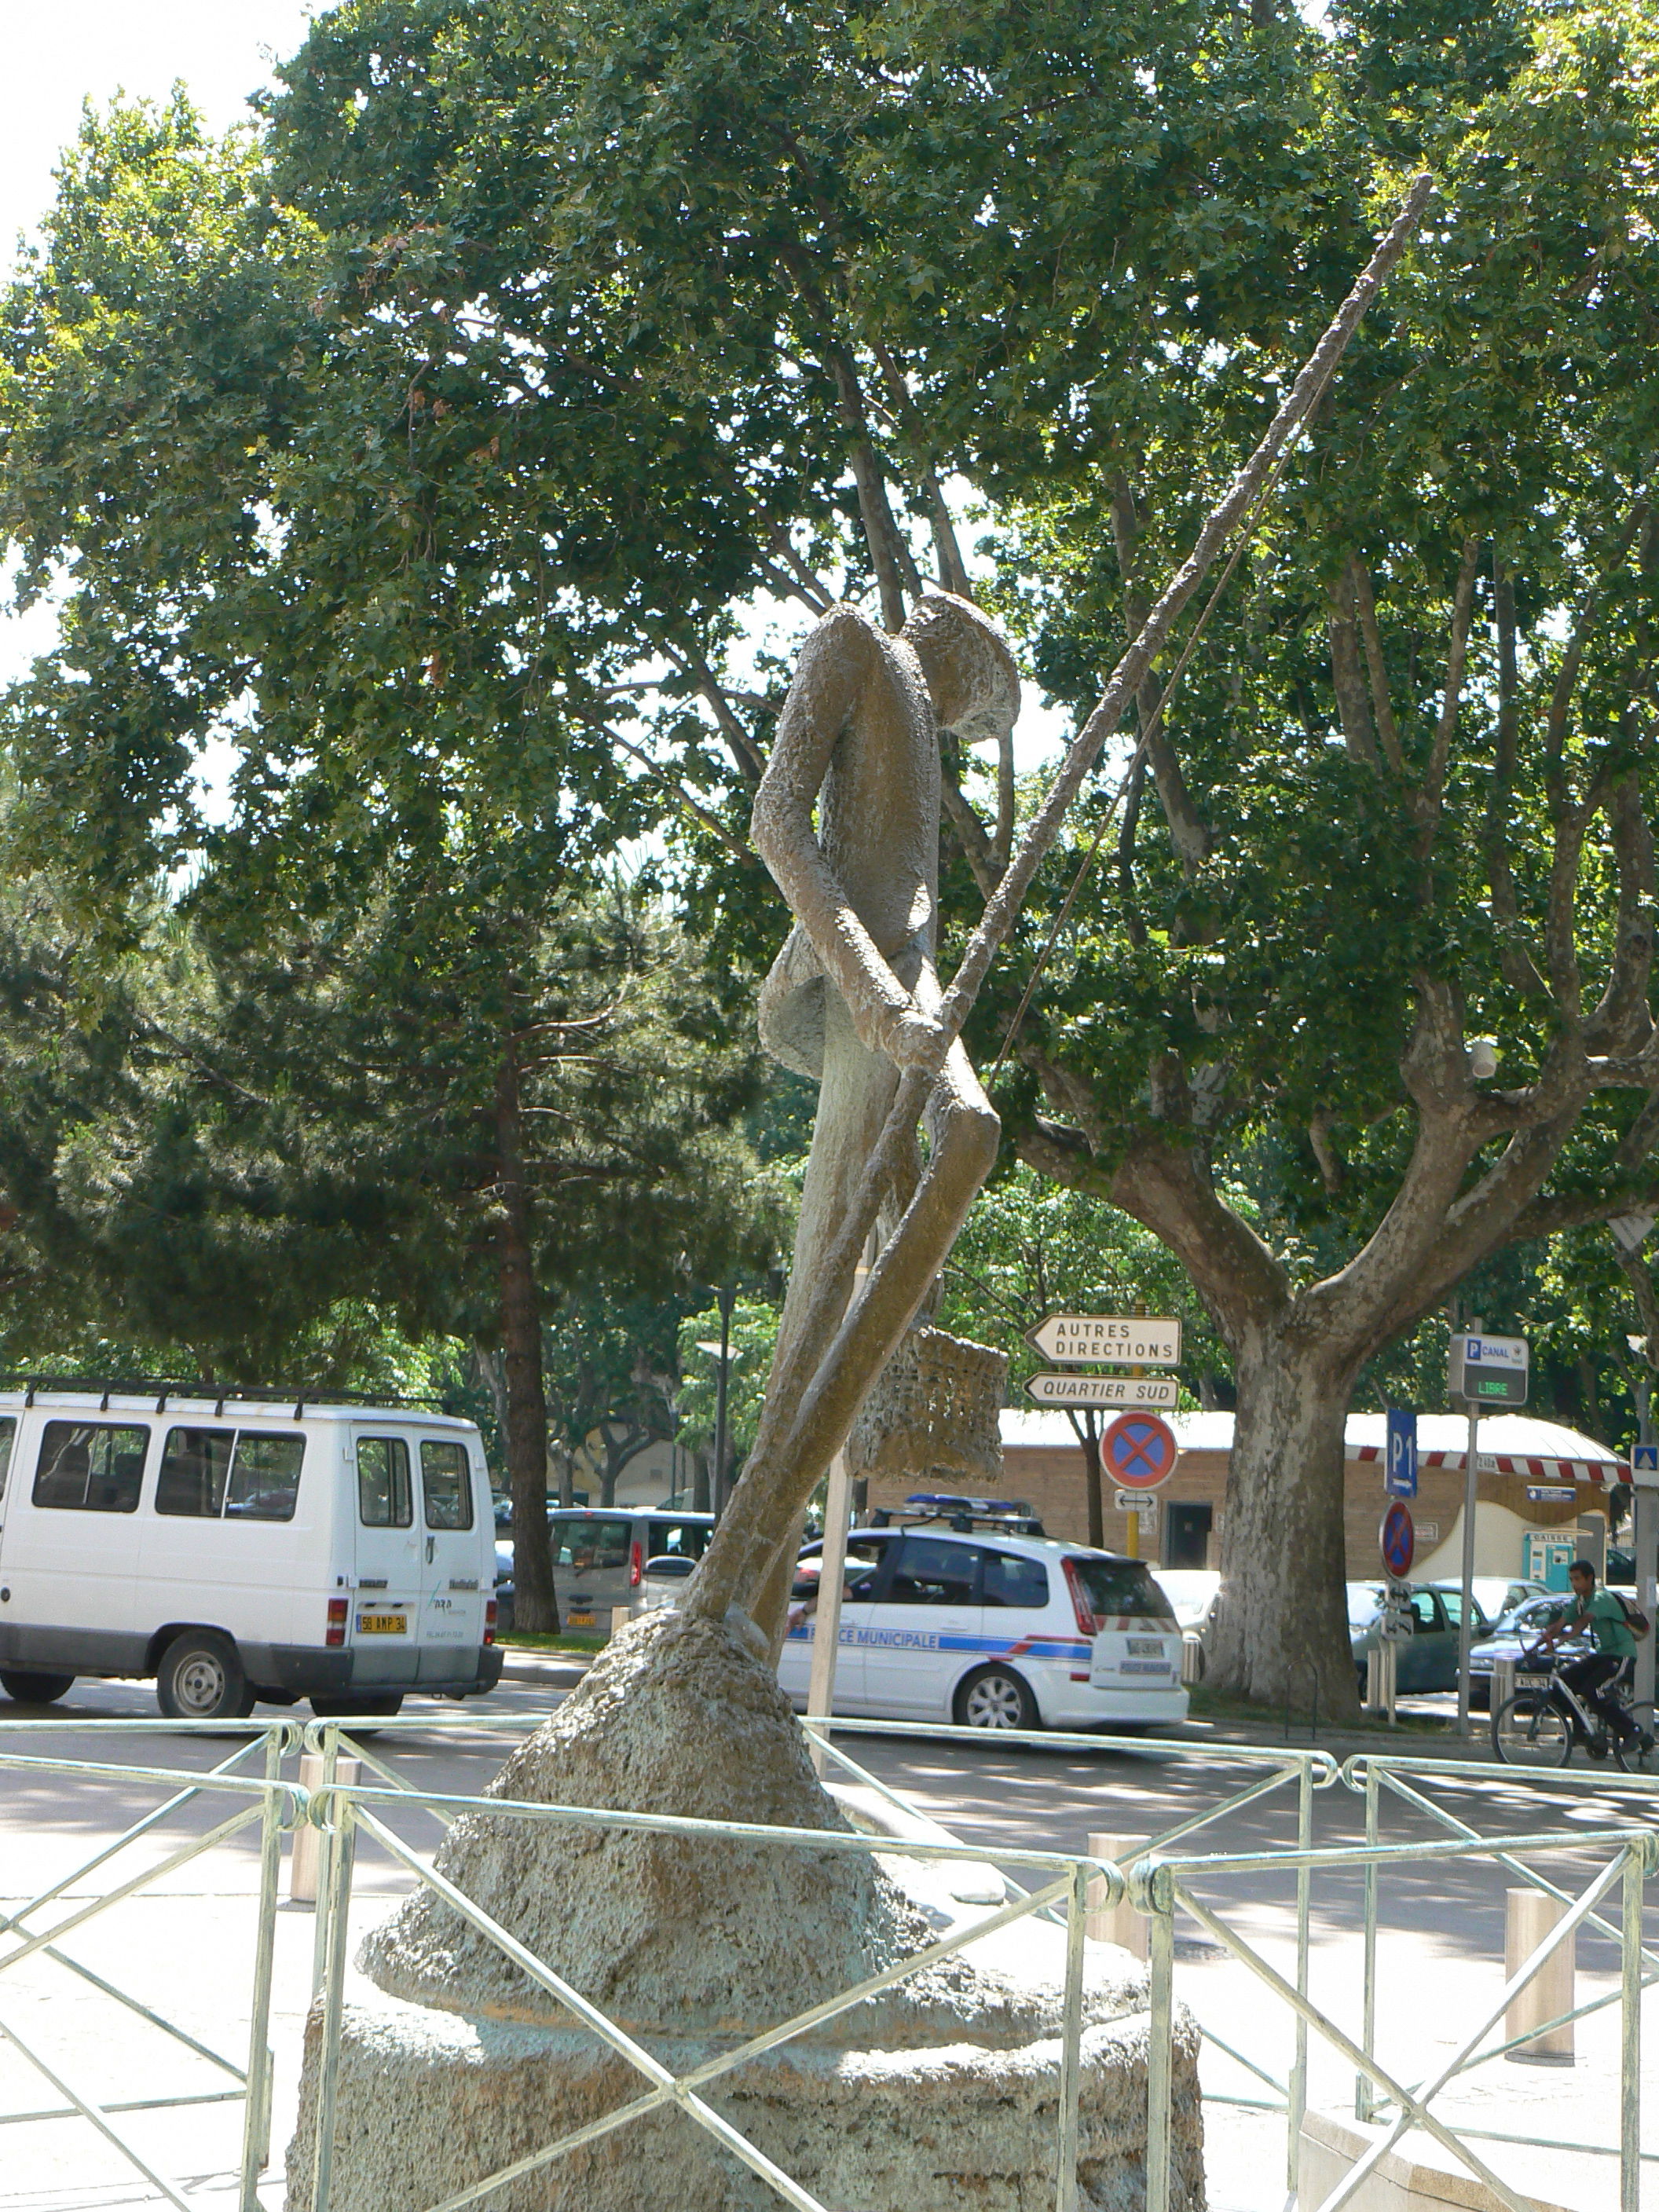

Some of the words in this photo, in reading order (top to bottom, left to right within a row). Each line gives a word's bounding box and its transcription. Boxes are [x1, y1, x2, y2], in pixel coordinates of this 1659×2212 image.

[1057, 1323, 1130, 1338] AUTRES
[1056, 1341, 1173, 1357] DIRECTIONS
[1481, 1346, 1510, 1358] CANAL
[1043, 1381, 1126, 1397] QUARTIER
[1136, 1385, 1170, 1400] SUD
[1478, 1381, 1508, 1396] LIBRE
[857, 1629, 936, 1649] MUNICIPALE
